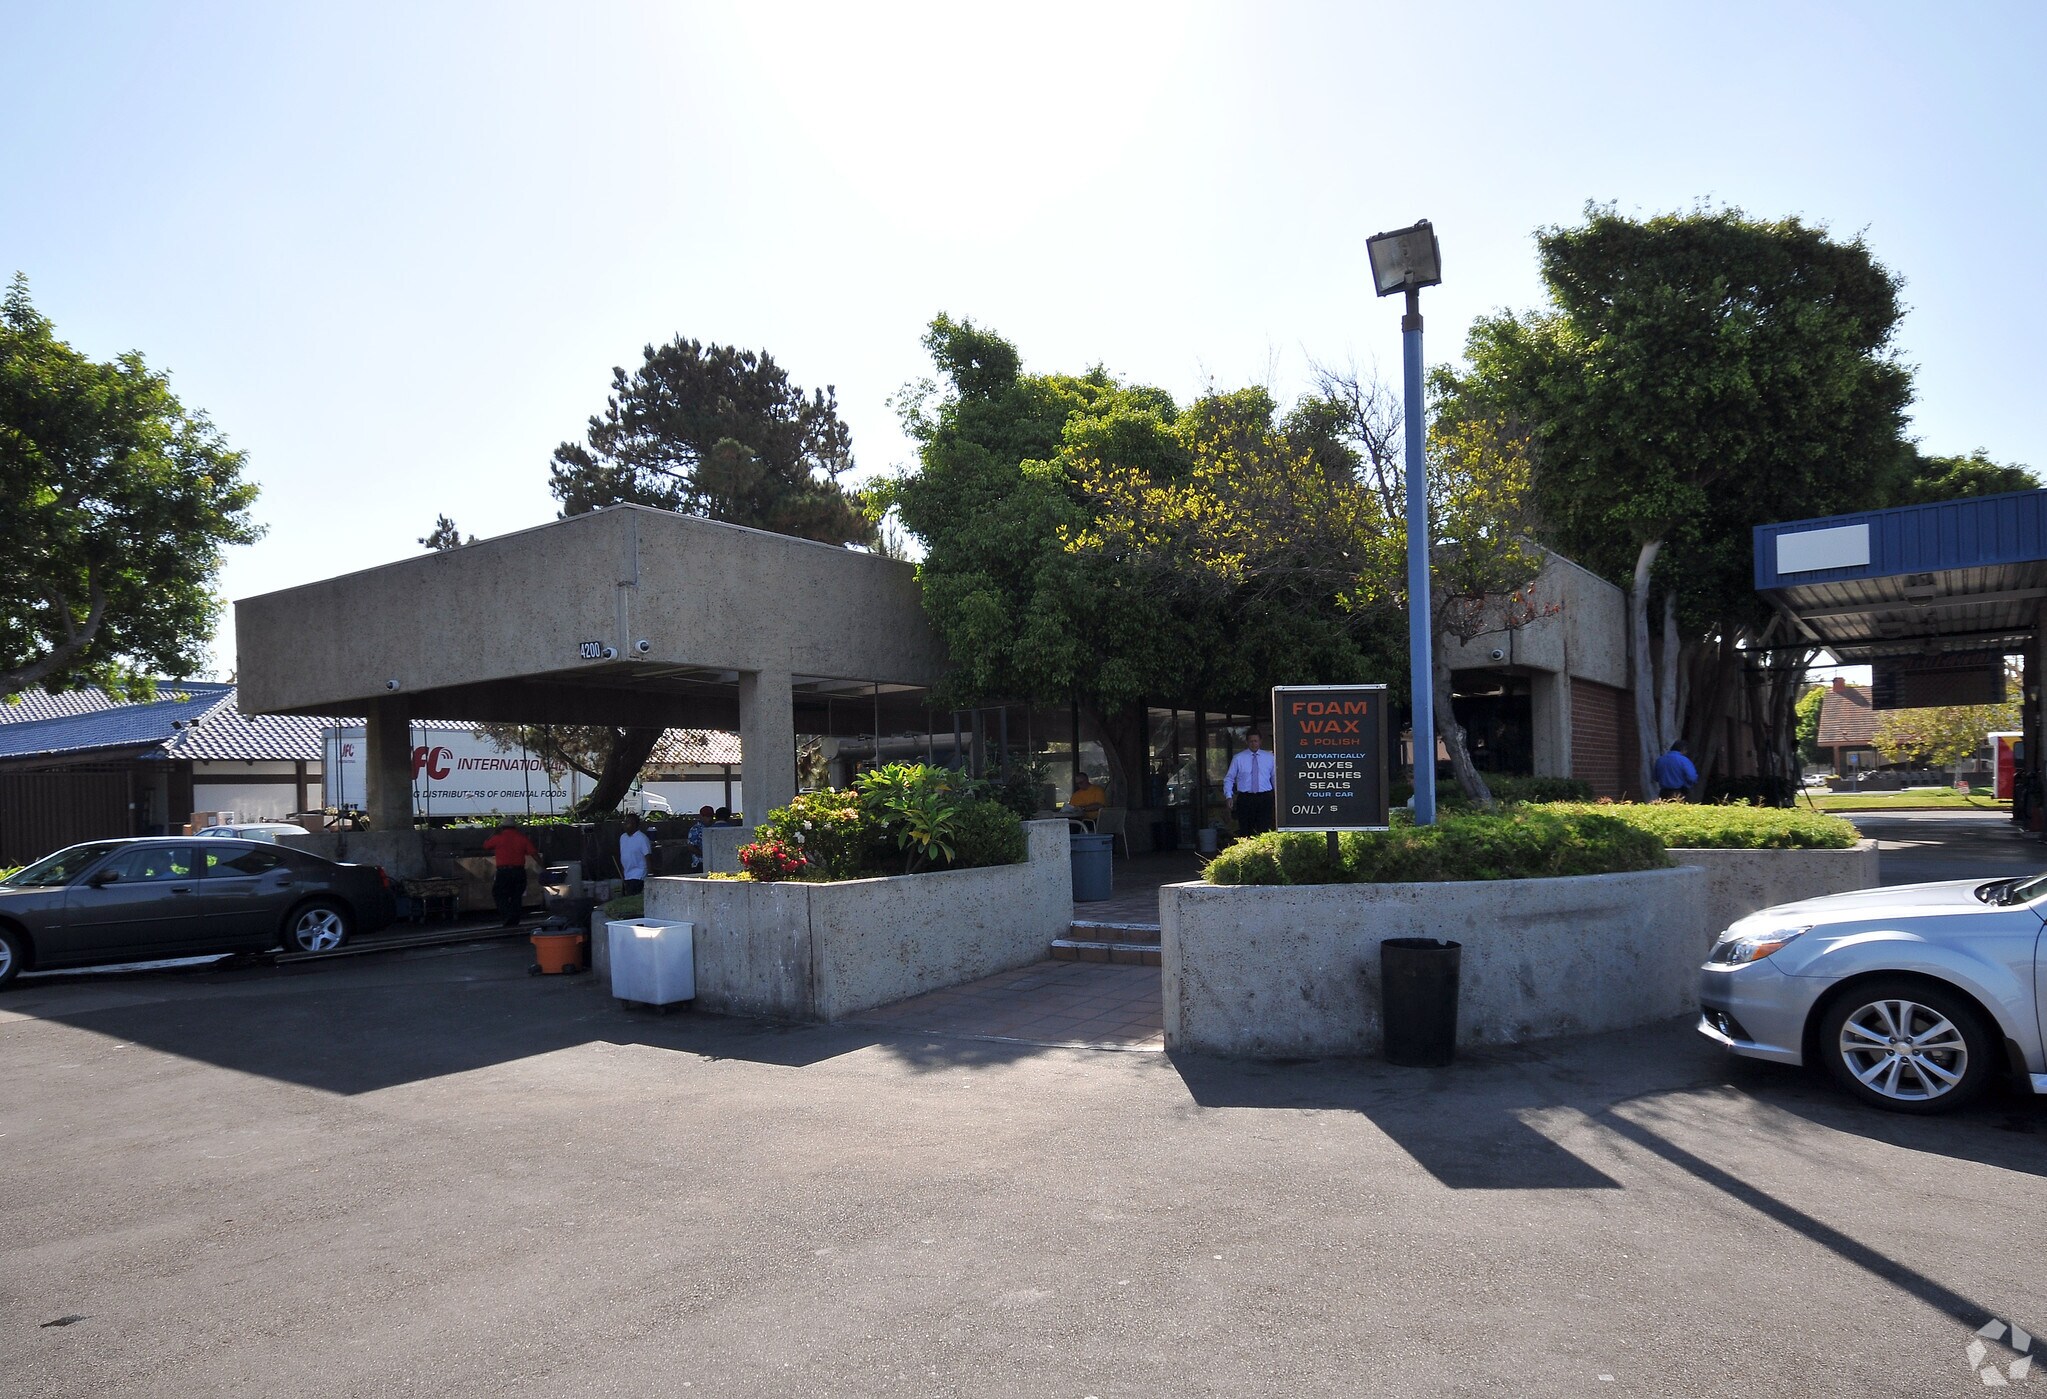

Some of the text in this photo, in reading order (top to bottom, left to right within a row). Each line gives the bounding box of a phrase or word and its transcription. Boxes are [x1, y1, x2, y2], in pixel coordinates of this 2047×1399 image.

[580, 642, 600, 658] 4200
[1292, 701, 1367, 715] FOAM
[1299, 720, 1360, 733] WAX
[1300, 738, 1360, 746] & POLISH
[1298, 771, 1362, 779] POLISHES
[1309, 781, 1351, 789] SEALS
[487, 790, 499, 799] OF
[500, 790, 539, 798] ORIENTAL
[540, 790, 567, 798] FOODS
[1291, 804, 1325, 815] ONLY
